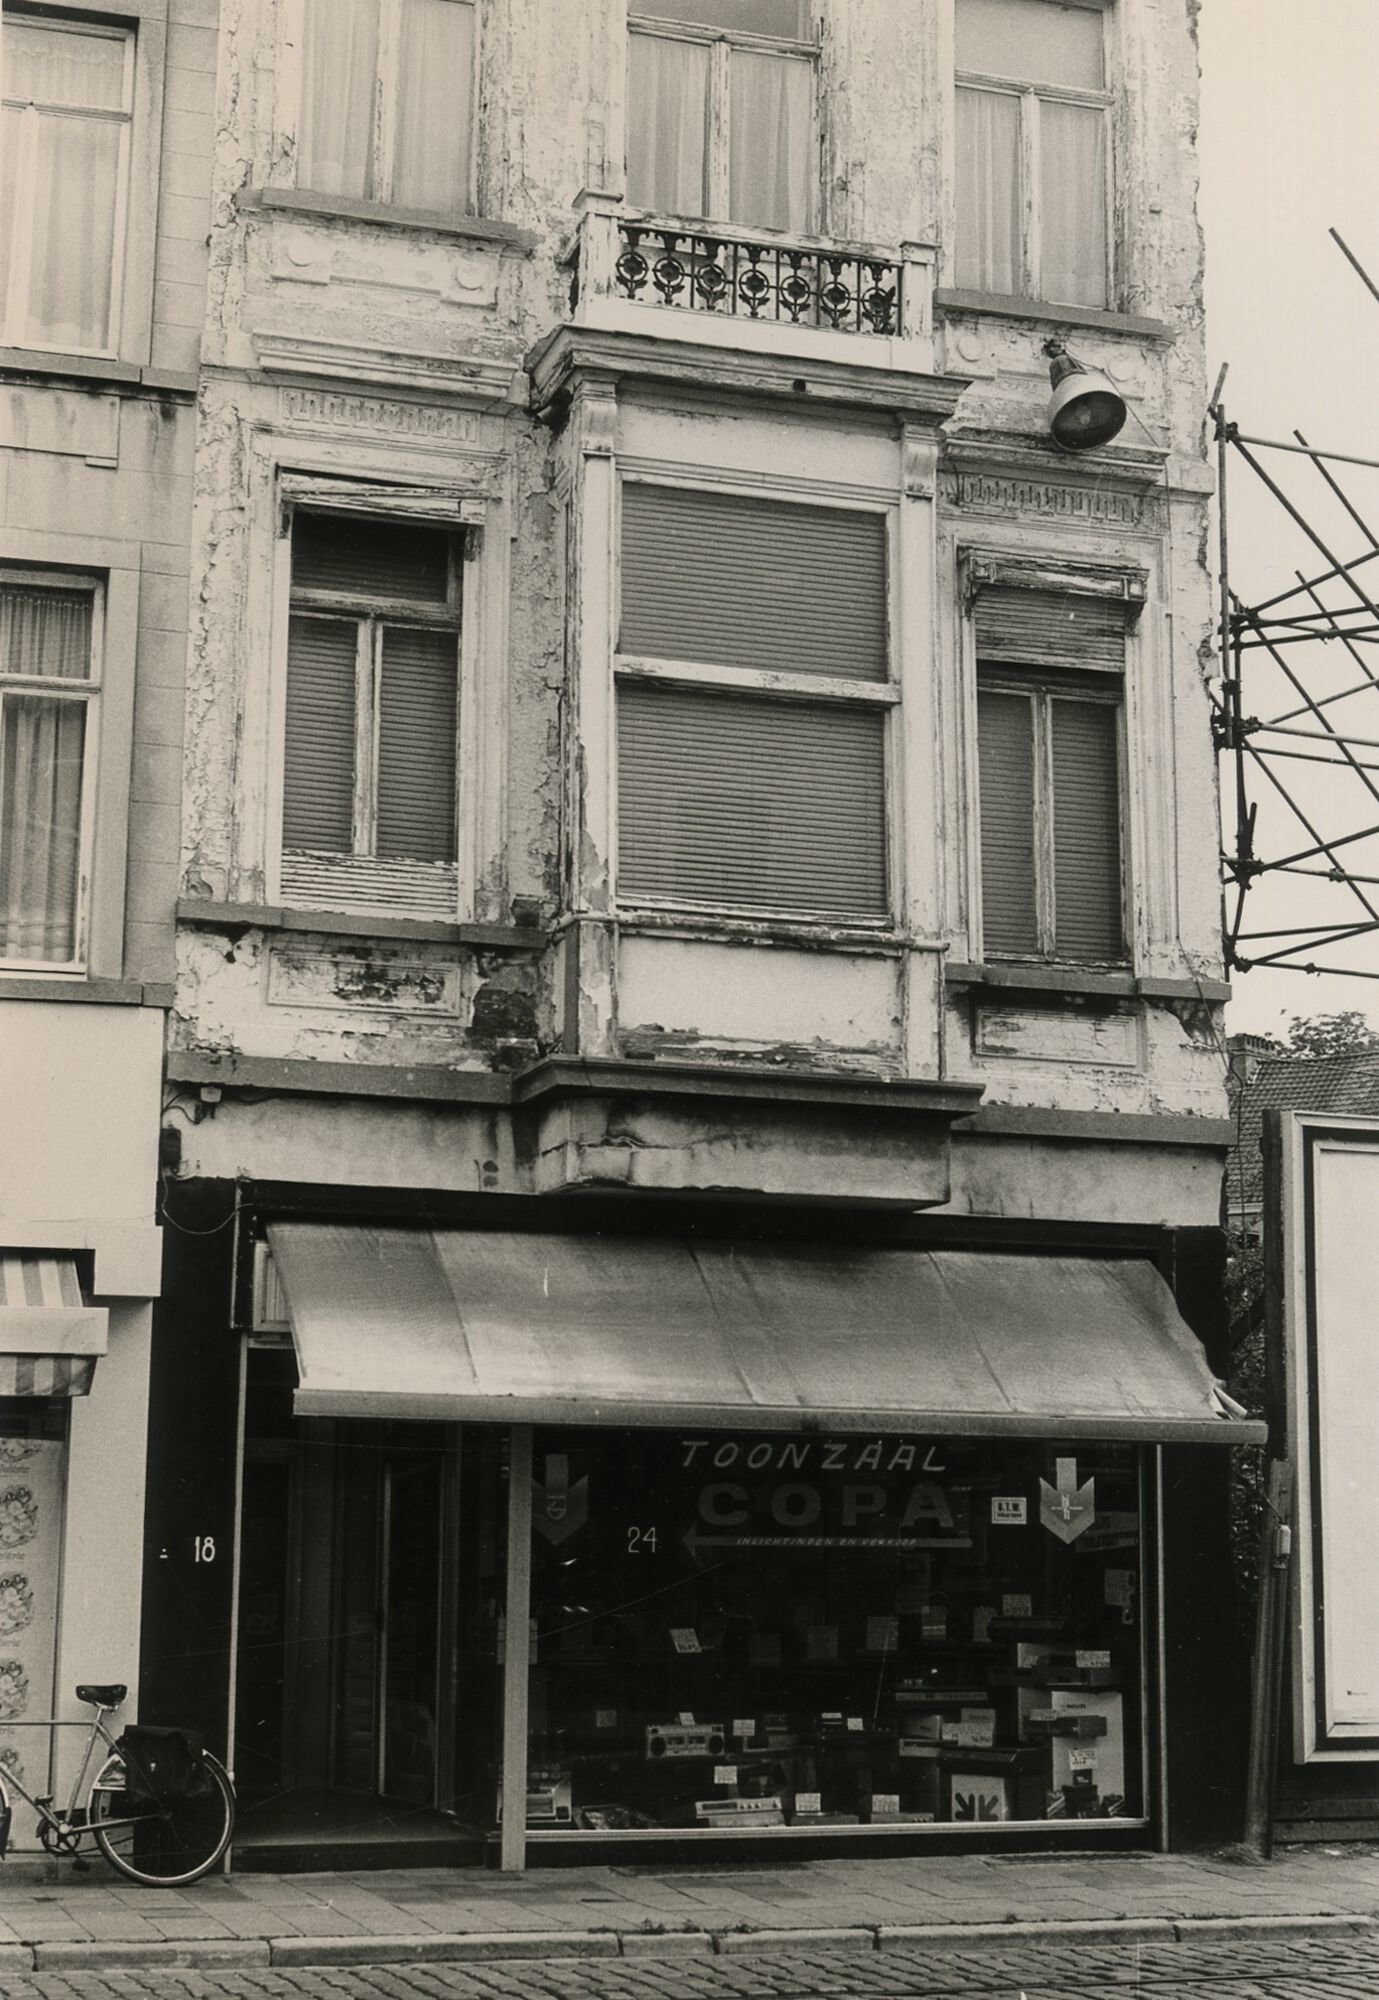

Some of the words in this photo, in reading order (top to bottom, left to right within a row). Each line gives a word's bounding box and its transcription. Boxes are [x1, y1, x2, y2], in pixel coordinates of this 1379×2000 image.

[681, 1441, 947, 1472] TOONZAAL
[698, 1482, 955, 1528] COPA
[194, 1536, 216, 1562] 18
[627, 1526, 658, 1553] 24
[839, 1537, 857, 1546] EN
[862, 1538, 918, 1547] VERKOOP
